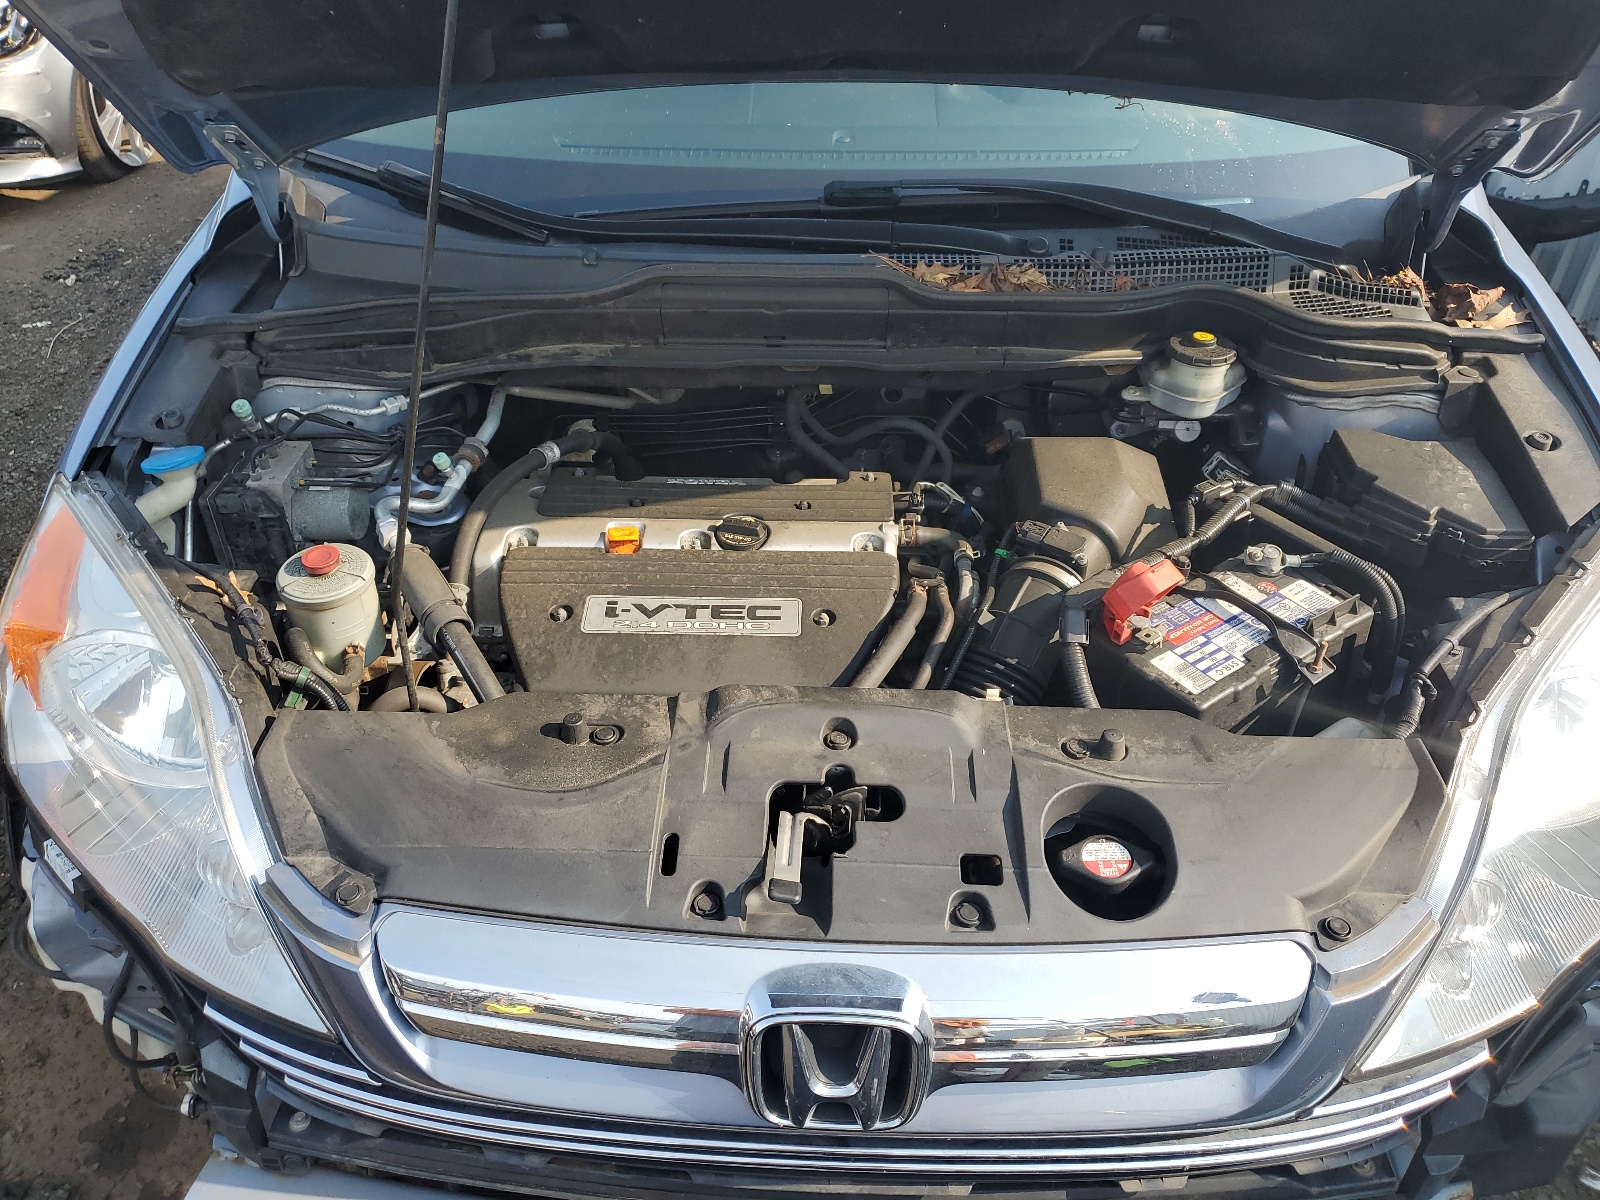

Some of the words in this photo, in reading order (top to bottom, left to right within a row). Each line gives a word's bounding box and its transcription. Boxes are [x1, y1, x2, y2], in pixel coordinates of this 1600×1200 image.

[604, 600, 782, 621] i-VTEC
[613, 620, 660, 629] 2.4
[666, 621, 771, 631] DOHC
[1214, 660, 1240, 675] 51R-C
